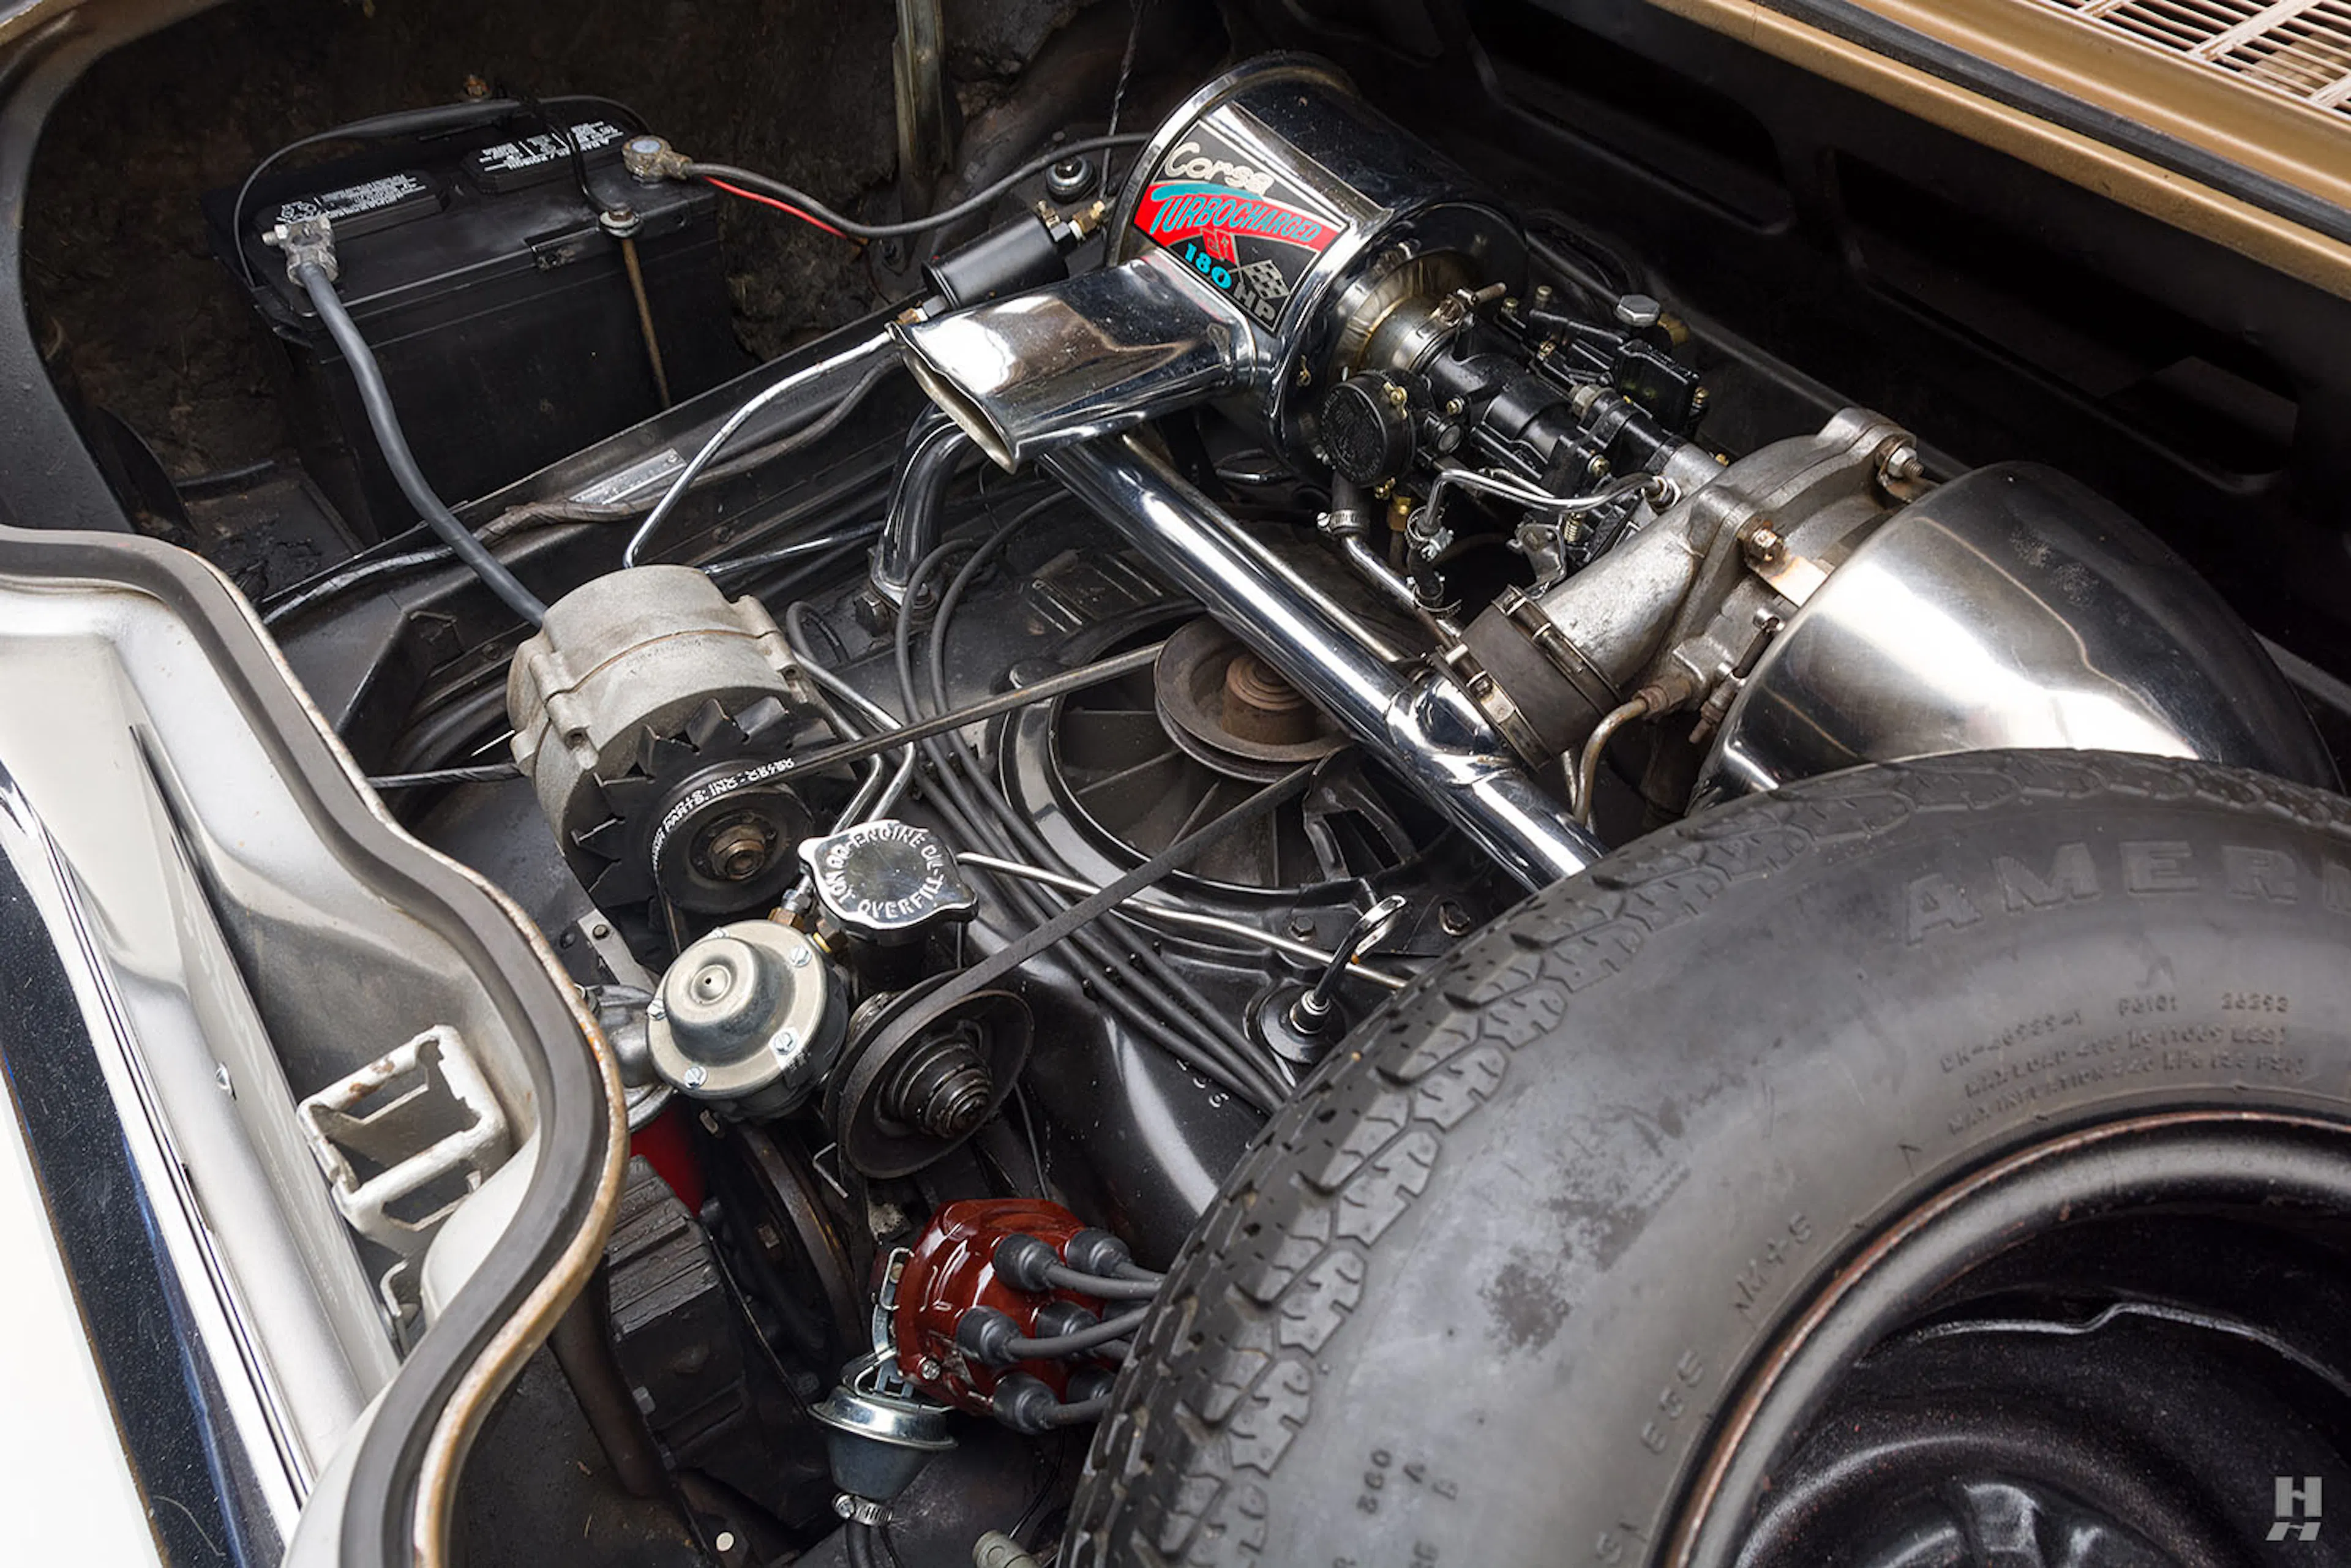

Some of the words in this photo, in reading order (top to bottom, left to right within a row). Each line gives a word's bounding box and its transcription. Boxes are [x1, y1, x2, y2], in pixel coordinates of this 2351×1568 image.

[1164, 141, 1275, 196] Corsa
[1150, 185, 1322, 242] TURBOCHARGED
[1185, 242, 1232, 289] 180
[1234, 281, 1276, 321] HP
[827, 843, 850, 869] DO
[851, 826, 926, 849] ENGINE
[921, 844, 945, 871] OIL
[825, 869, 856, 904] NOT
[857, 874, 945, 919] OVERFILL
